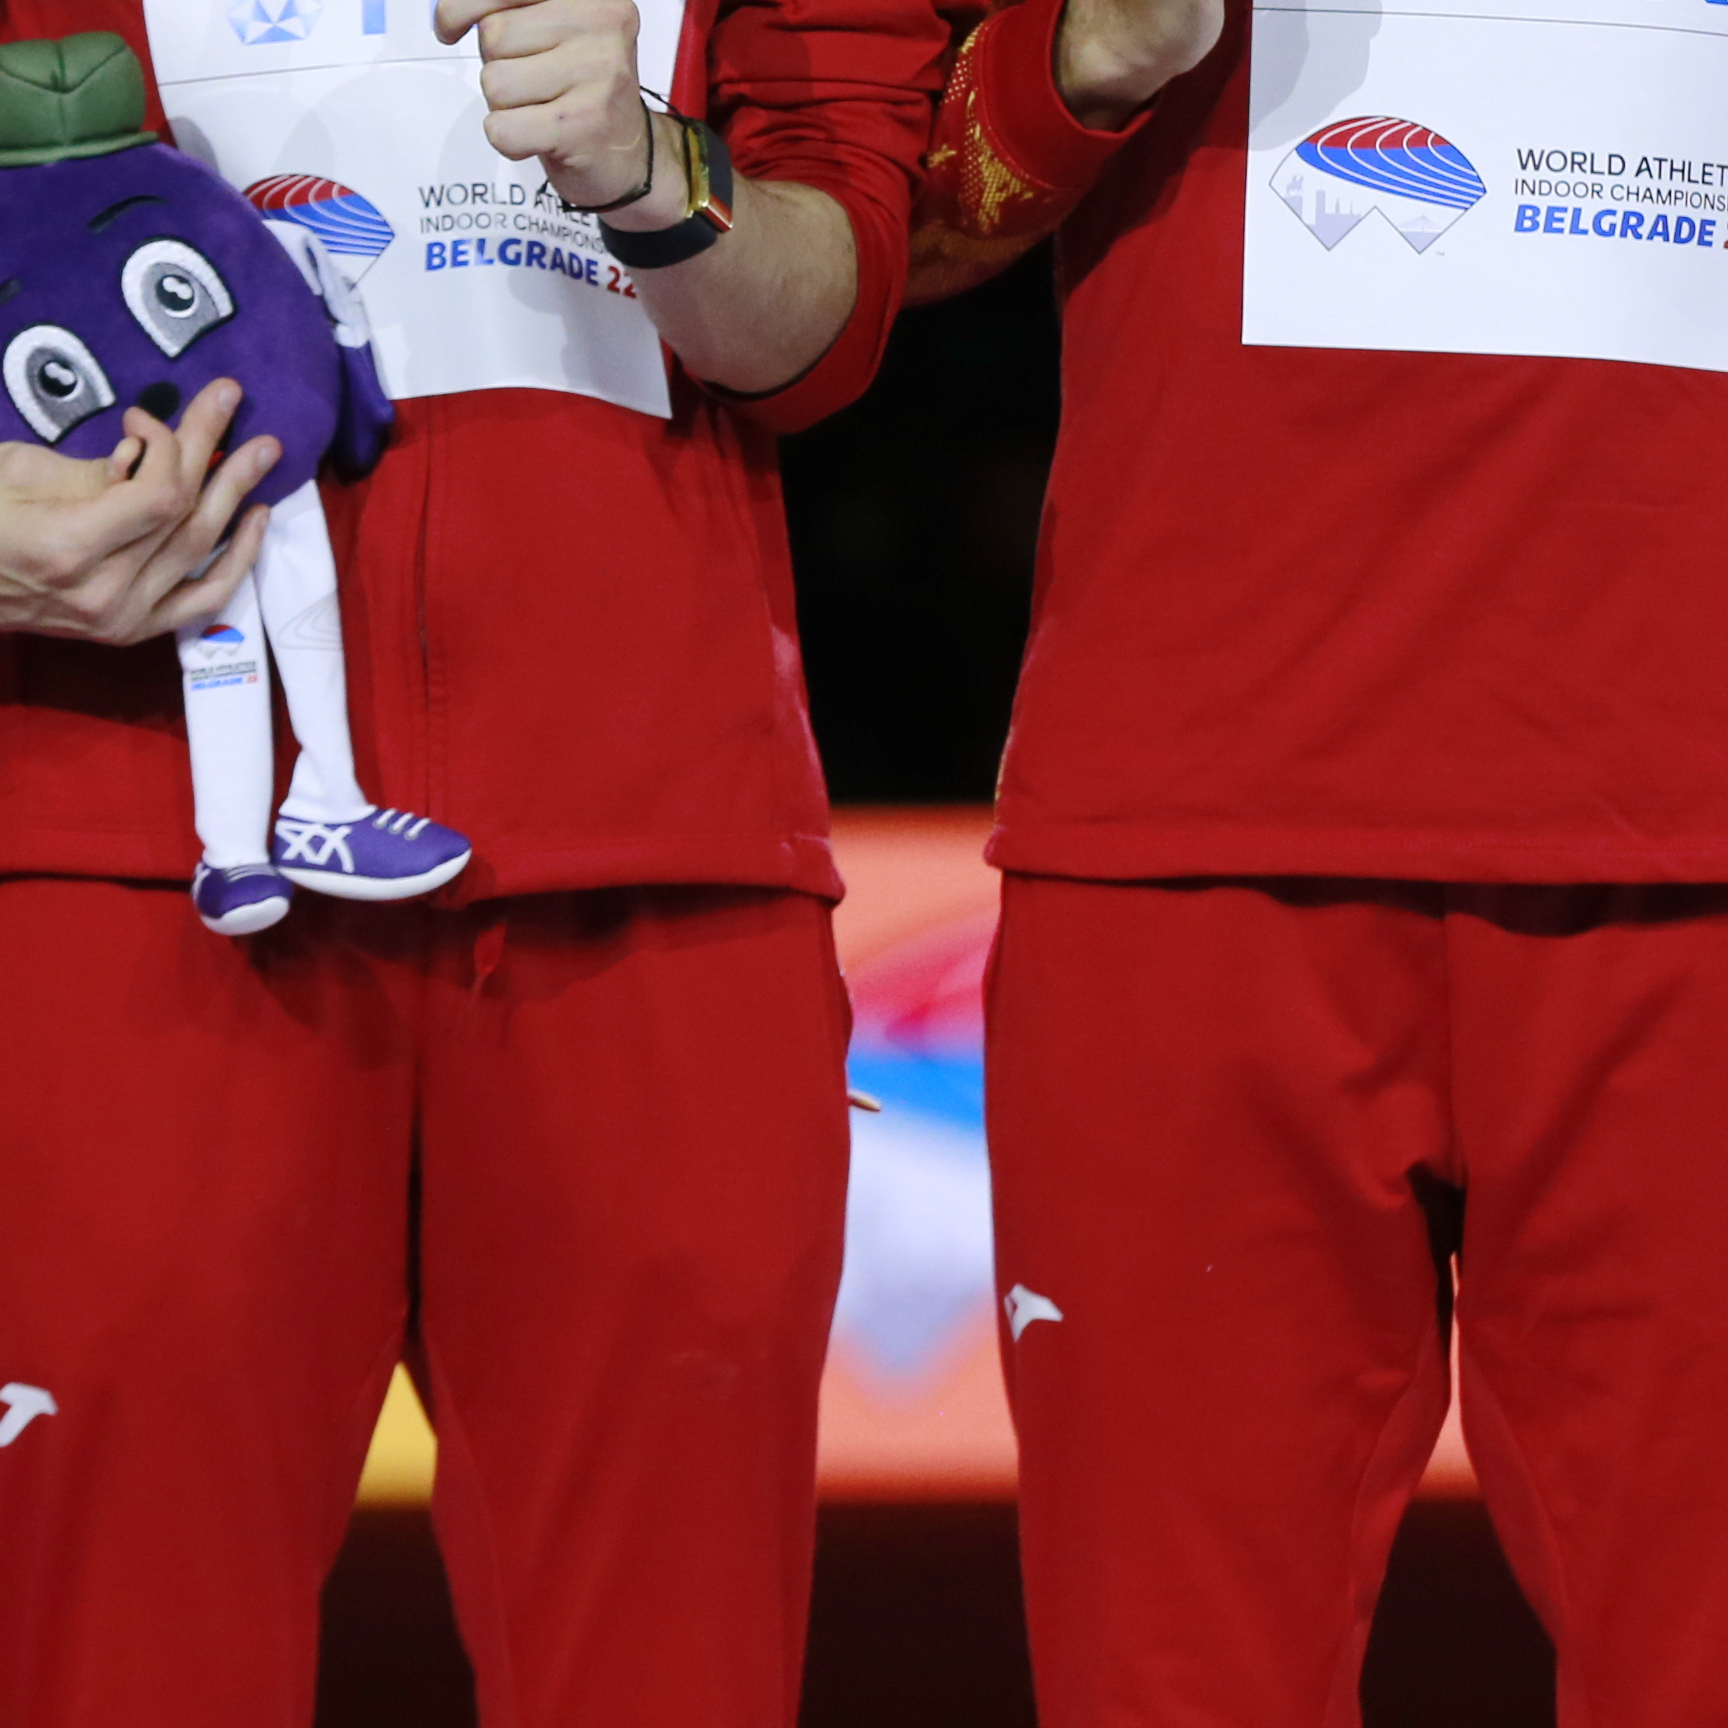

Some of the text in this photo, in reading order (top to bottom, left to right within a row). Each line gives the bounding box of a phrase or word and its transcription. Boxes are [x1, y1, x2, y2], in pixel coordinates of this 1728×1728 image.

[1517, 148, 1626, 177] WORLD
[419, 182, 526, 208] WORLD
[1514, 178, 1603, 200] INDOOR
[419, 212, 605, 254] INDOOR CHAMPIONS
[1514, 203, 1716, 248] BELGRADE
[425, 237, 599, 287] BELGRADE
